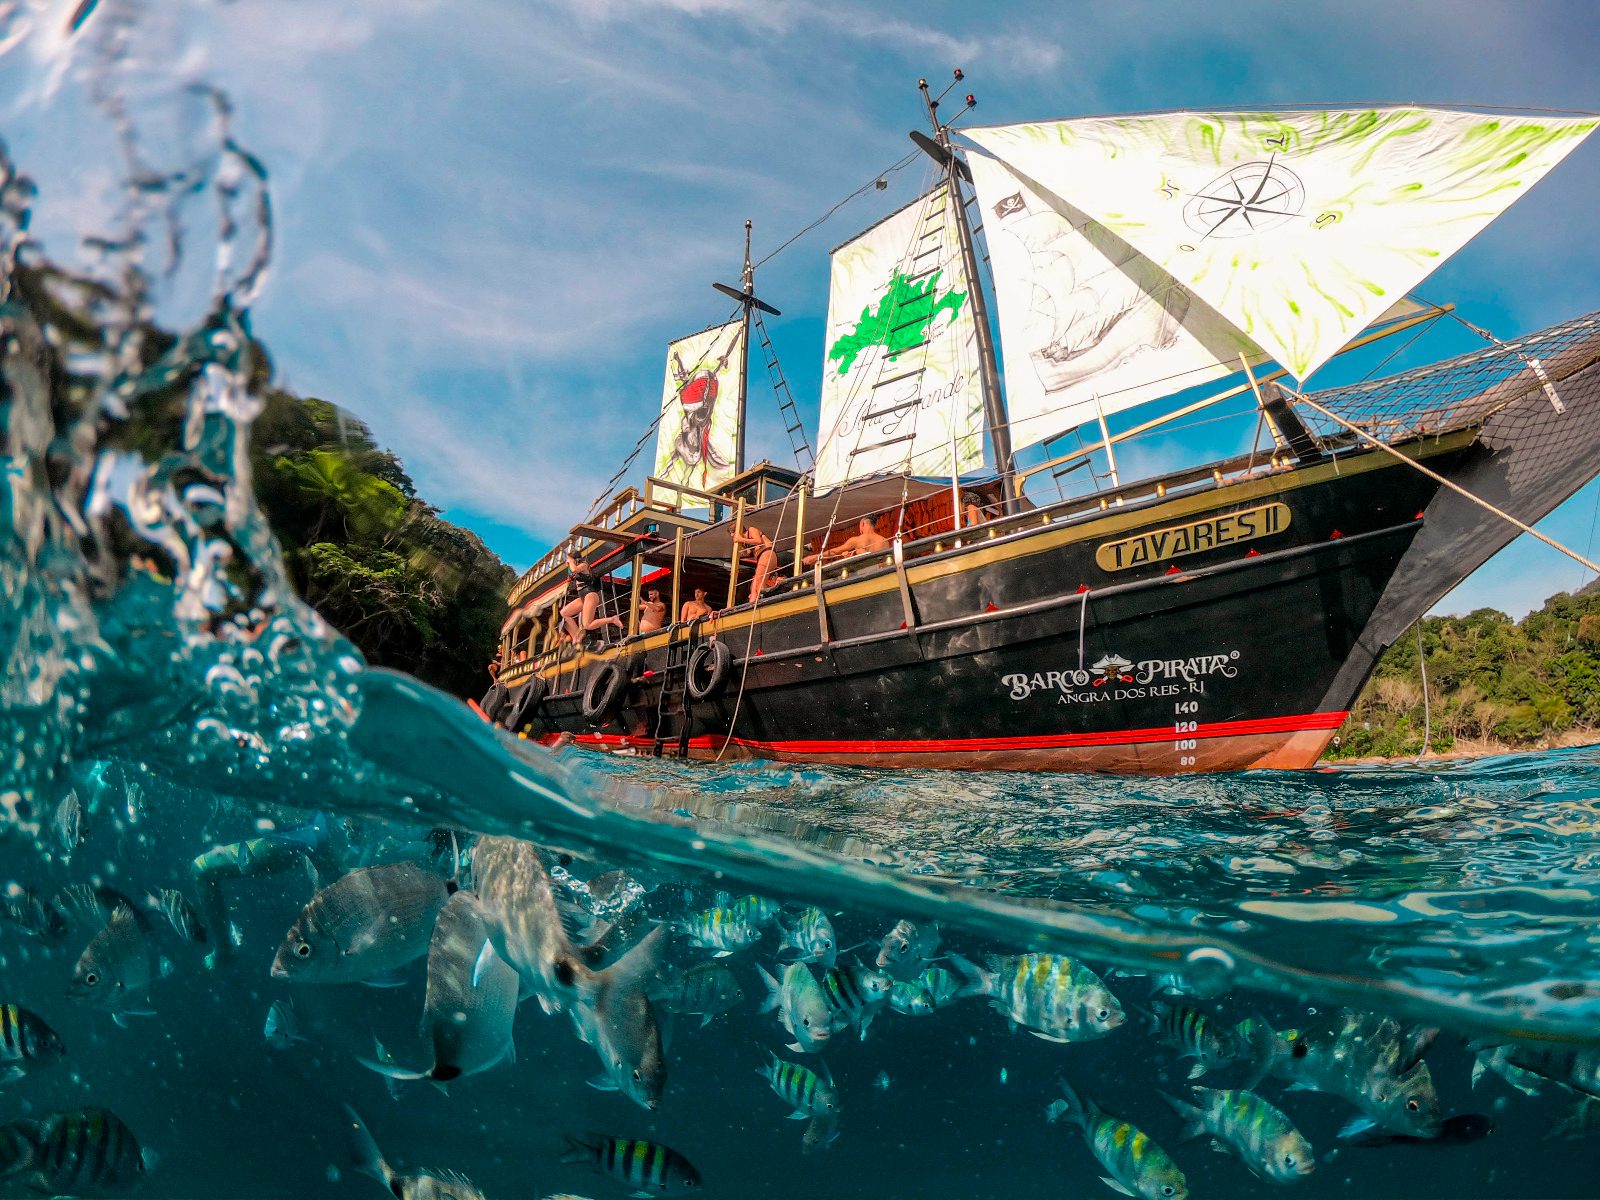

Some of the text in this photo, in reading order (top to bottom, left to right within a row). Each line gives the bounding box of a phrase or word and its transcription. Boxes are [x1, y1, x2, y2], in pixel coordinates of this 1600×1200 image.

[1108, 505, 1281, 569] TAVARES II
[1001, 669, 1091, 701] BARCO
[1057, 691, 1111, 705] ANGRA
[1114, 688, 1147, 701] DOS
[1149, 684, 1180, 697] REIS
[1174, 700, 1199, 715] 140
[1175, 720, 1198, 733] 120
[1174, 739, 1197, 751] 100
[1180, 756, 1196, 766] 80
